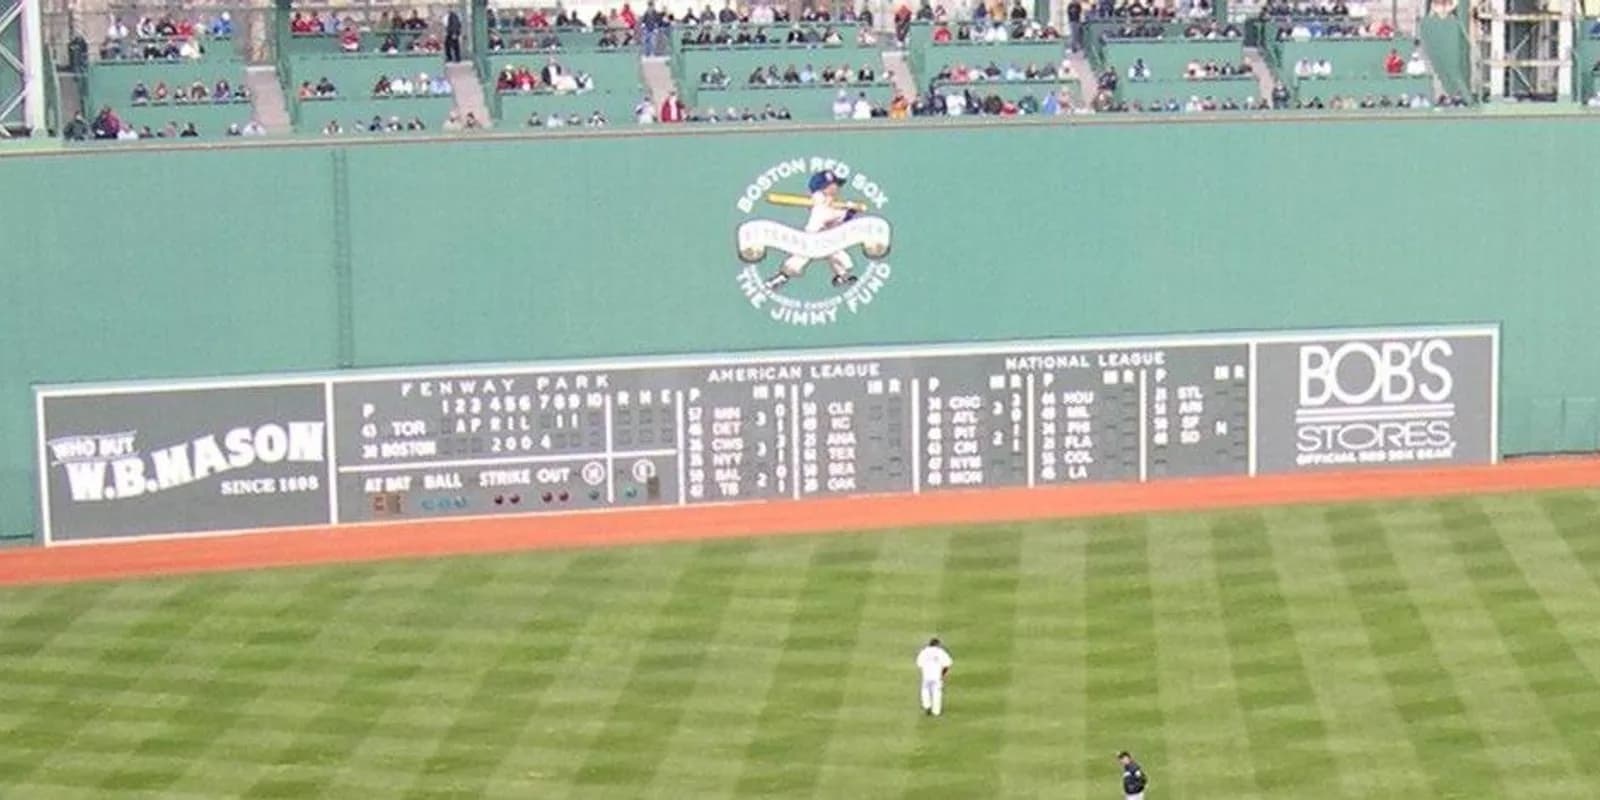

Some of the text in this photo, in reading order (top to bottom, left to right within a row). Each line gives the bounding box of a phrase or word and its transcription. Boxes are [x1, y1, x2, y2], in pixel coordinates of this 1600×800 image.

[736, 156, 889, 214] BOSTON RED SOX
[736, 268, 768, 309] THE
[770, 305, 838, 326] JIMMY
[846, 262, 891, 314] FUND
[1005, 351, 1165, 371] NATIONAL LEAGUE
[707, 362, 880, 382] AMERICAN LEAGUE
[1299, 339, 1453, 406] BOB'S
[401, 375, 609, 397] FENWAY PARK
[362, 403, 375, 418] P
[828, 401, 853, 416] CLE
[392, 420, 427, 437] TOR
[1296, 419, 1451, 452] STORES
[381, 440, 436, 458] BOSTON
[1065, 435, 1092, 450] FLA
[713, 452, 743, 466] NYY
[1064, 450, 1094, 464] COL
[365, 477, 383, 492] AT
[385, 476, 411, 492] BAT
[423, 472, 463, 489] BALL
[480, 469, 531, 488] STRIKE
[536, 467, 571, 483] OUT
[1068, 465, 1088, 479] LA
[221, 478, 275, 494] SINCE
